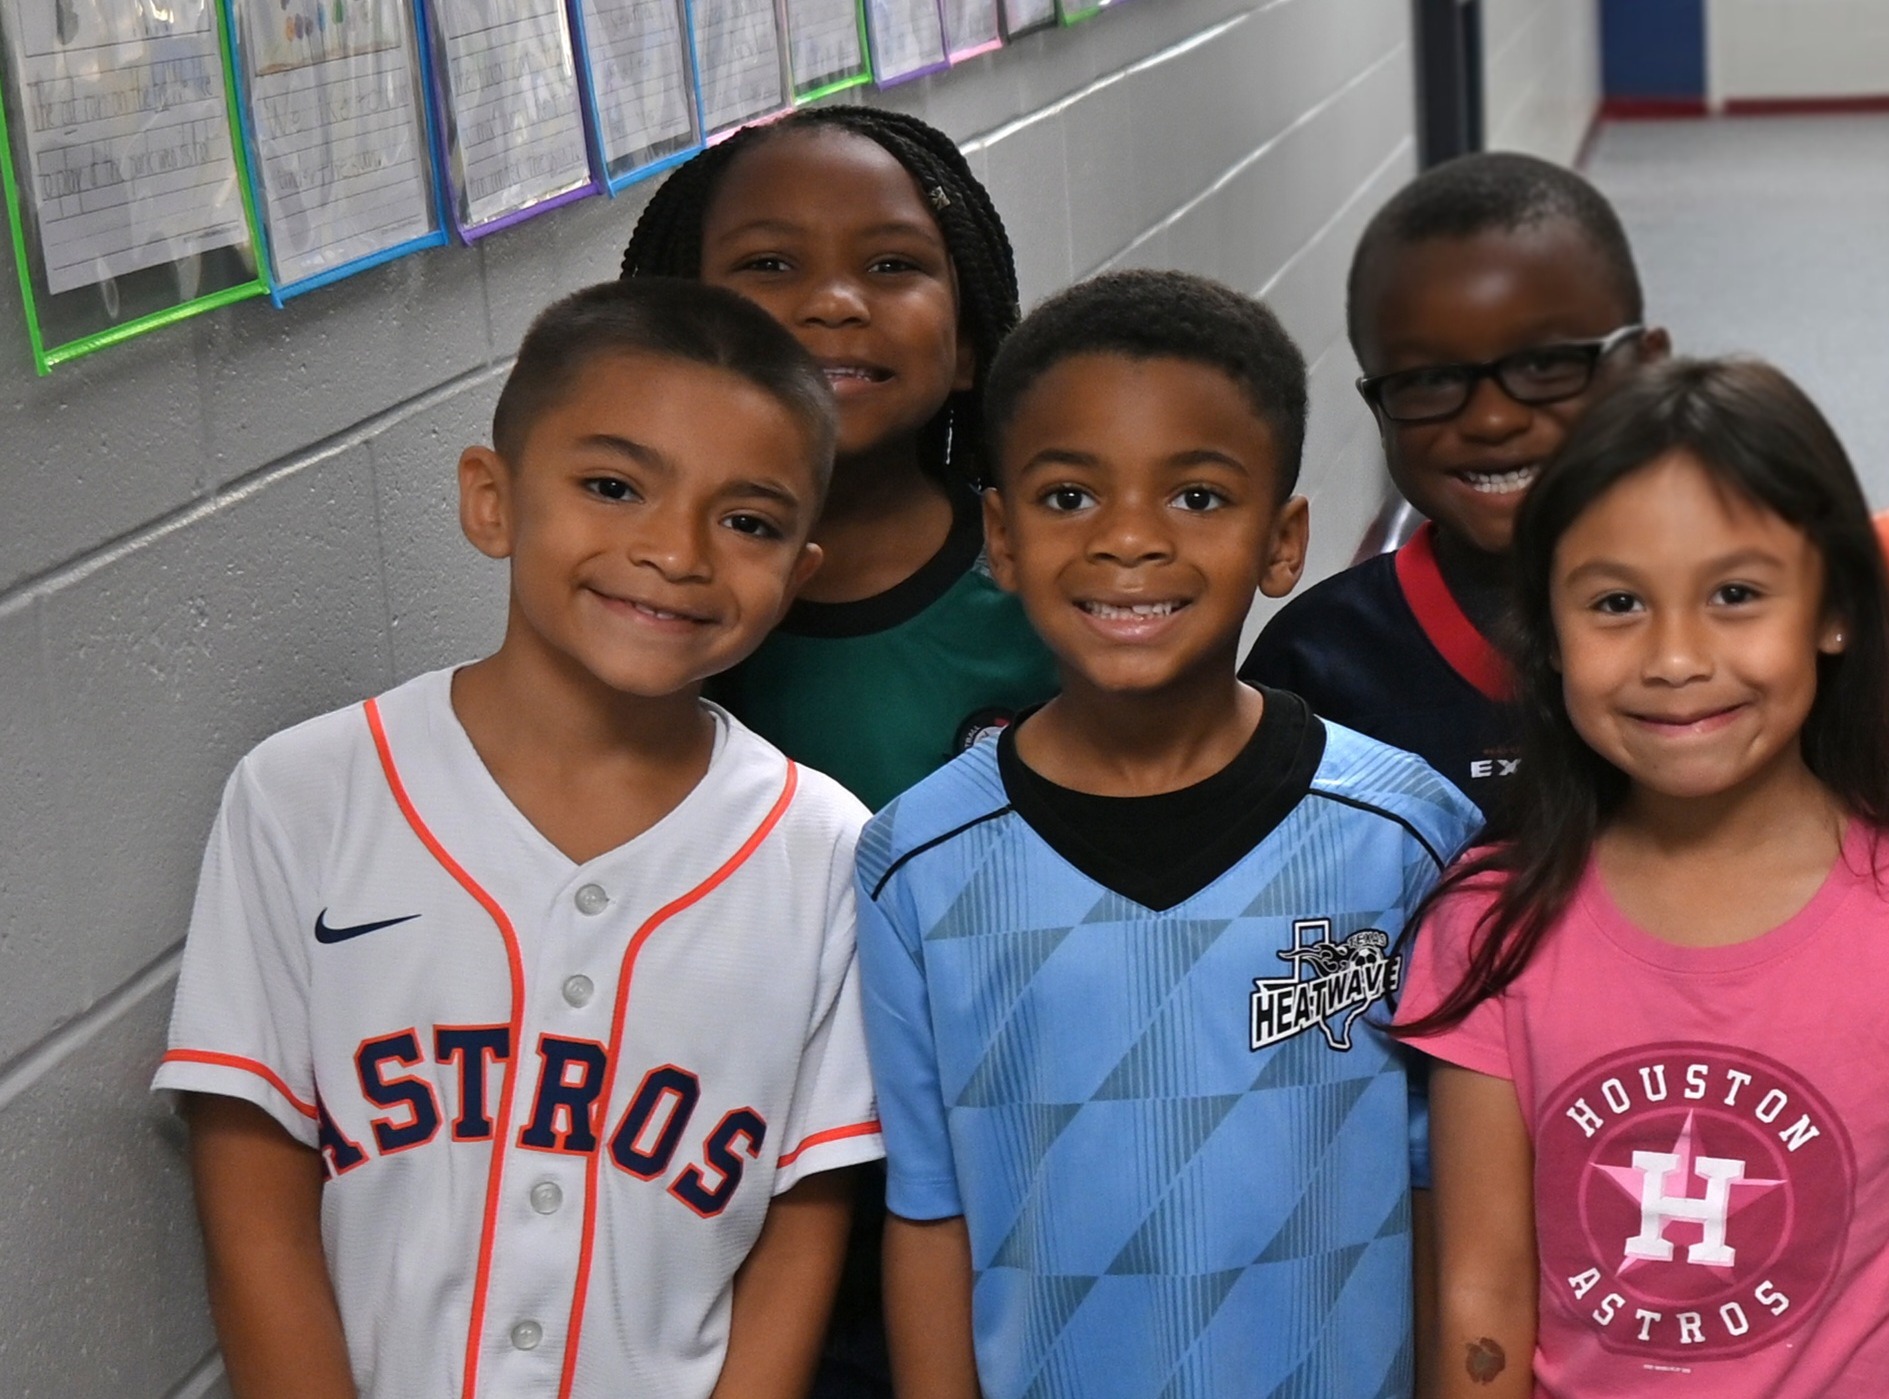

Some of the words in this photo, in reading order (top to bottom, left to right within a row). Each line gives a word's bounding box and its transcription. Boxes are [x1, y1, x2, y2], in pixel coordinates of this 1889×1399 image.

[1471, 760, 1522, 778] EX
[1349, 931, 1386, 948] TEXAS
[1254, 957, 1399, 1047] HEATWAVE
[1566, 1064, 1820, 1152] HOUSTON
[1624, 1150, 1746, 1267] H
[1568, 1267, 1790, 1344] ASTROS
